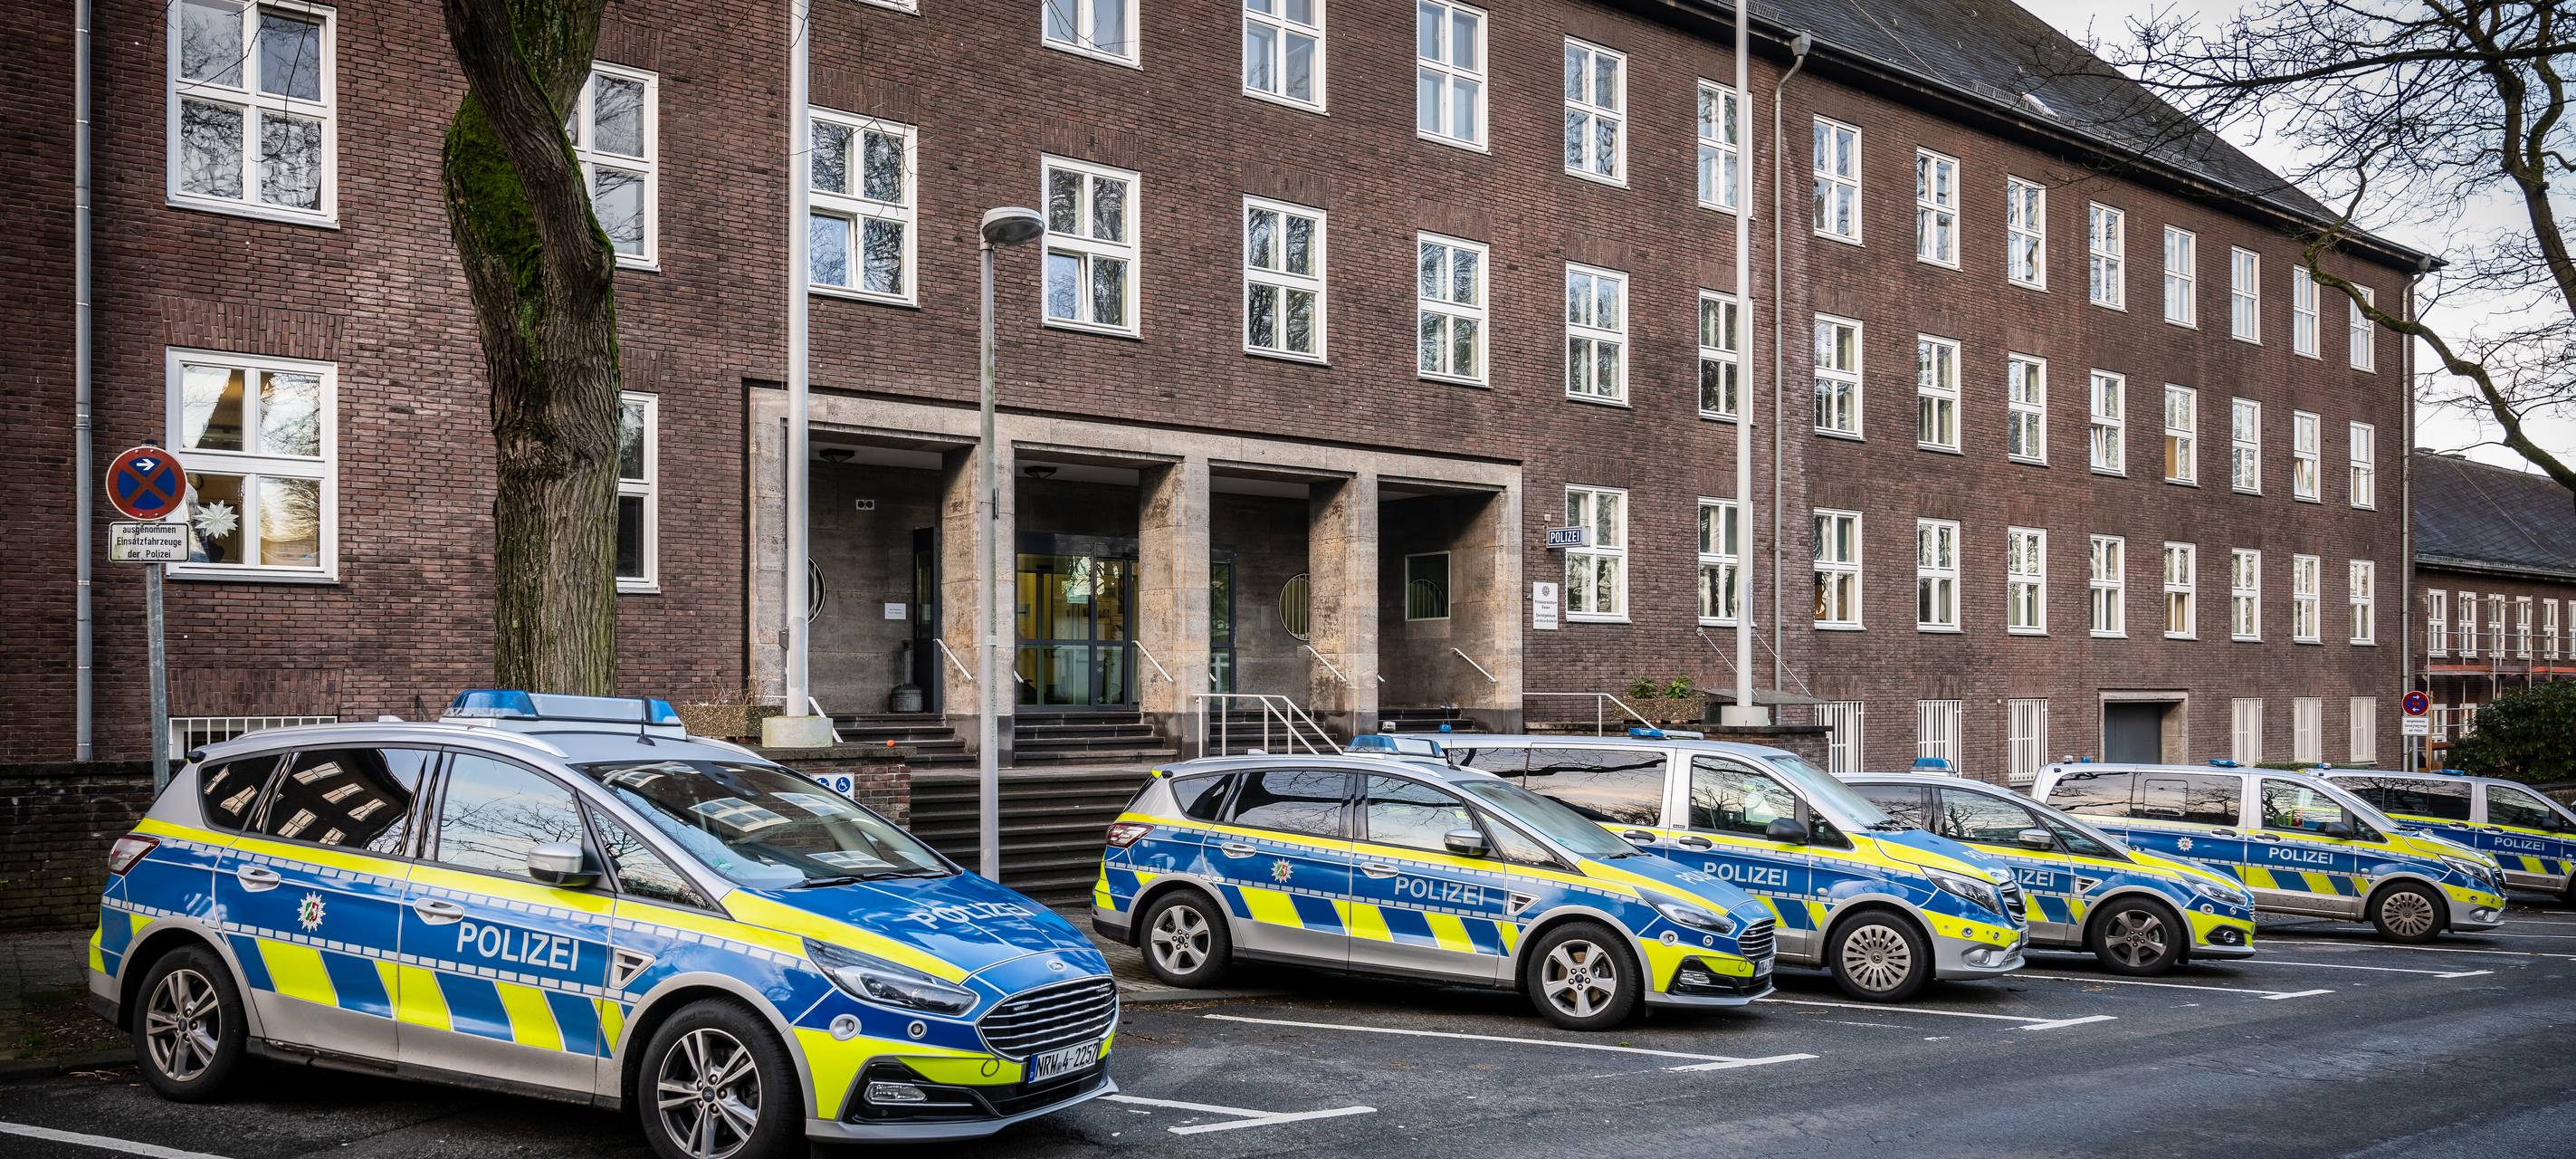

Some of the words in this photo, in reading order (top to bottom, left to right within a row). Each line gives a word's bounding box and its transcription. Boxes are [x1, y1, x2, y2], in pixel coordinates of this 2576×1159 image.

[123, 526, 177, 535] ausgenommen
[1550, 531, 1579, 543] POLIZEI
[117, 537, 182, 548] Einsatzfahrzeuge
[128, 550, 140, 558] der
[146, 550, 171, 558] Polizei
[2494, 837, 2545, 851] POLIZEI
[2268, 847, 2333, 865] POLIZEI
[1703, 861, 1788, 886] POLIZEI
[2018, 868, 2055, 887] IZEI
[1394, 876, 1484, 906] POLIZEI
[907, 902, 1037, 930] POLIZEI
[456, 921, 580, 972] POLIZEI
[1035, 1053, 1059, 1078] NRW
